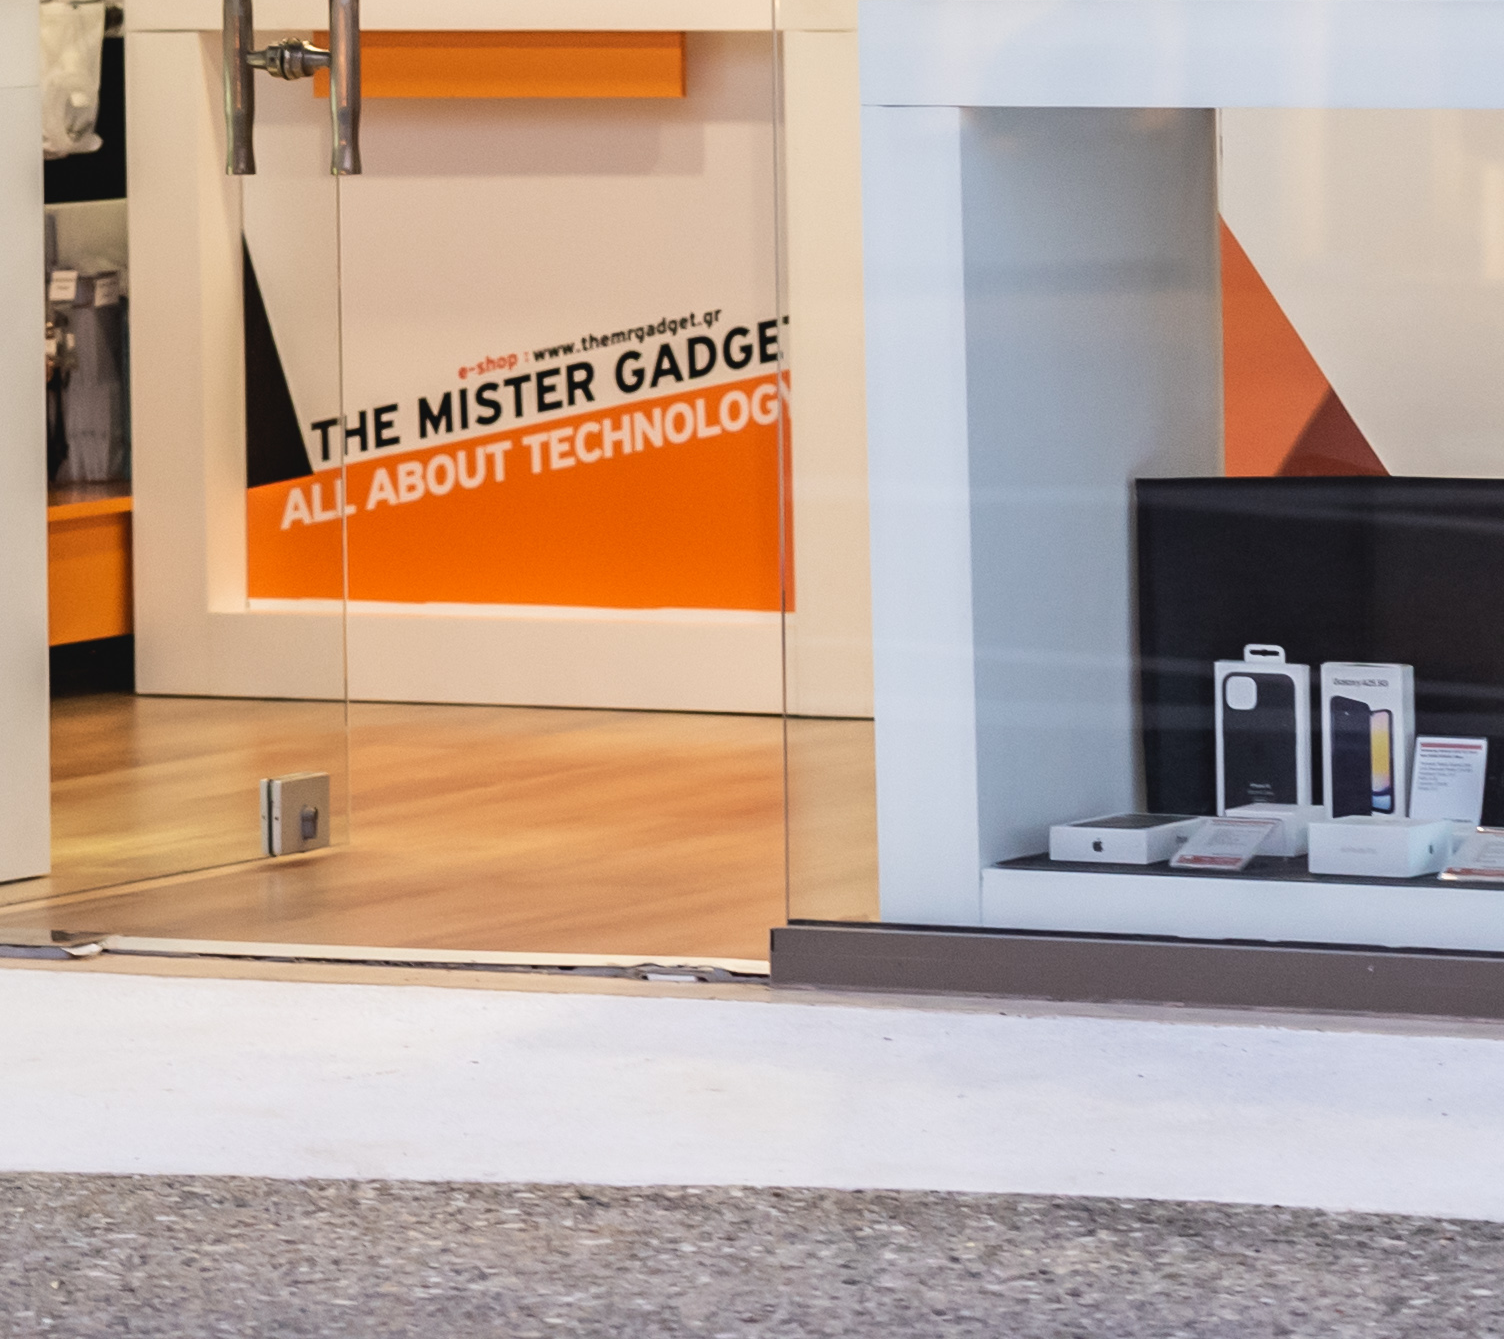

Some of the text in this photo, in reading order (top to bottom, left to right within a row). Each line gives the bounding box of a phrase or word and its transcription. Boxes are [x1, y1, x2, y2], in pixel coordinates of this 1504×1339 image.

[311, 314, 790, 462] THE MISTER GADGE
[457, 350, 518, 381] e-shop
[533, 307, 722, 364] www.themrgadget.gr
[280, 479, 357, 531] ALL
[367, 440, 513, 511] ABOUT
